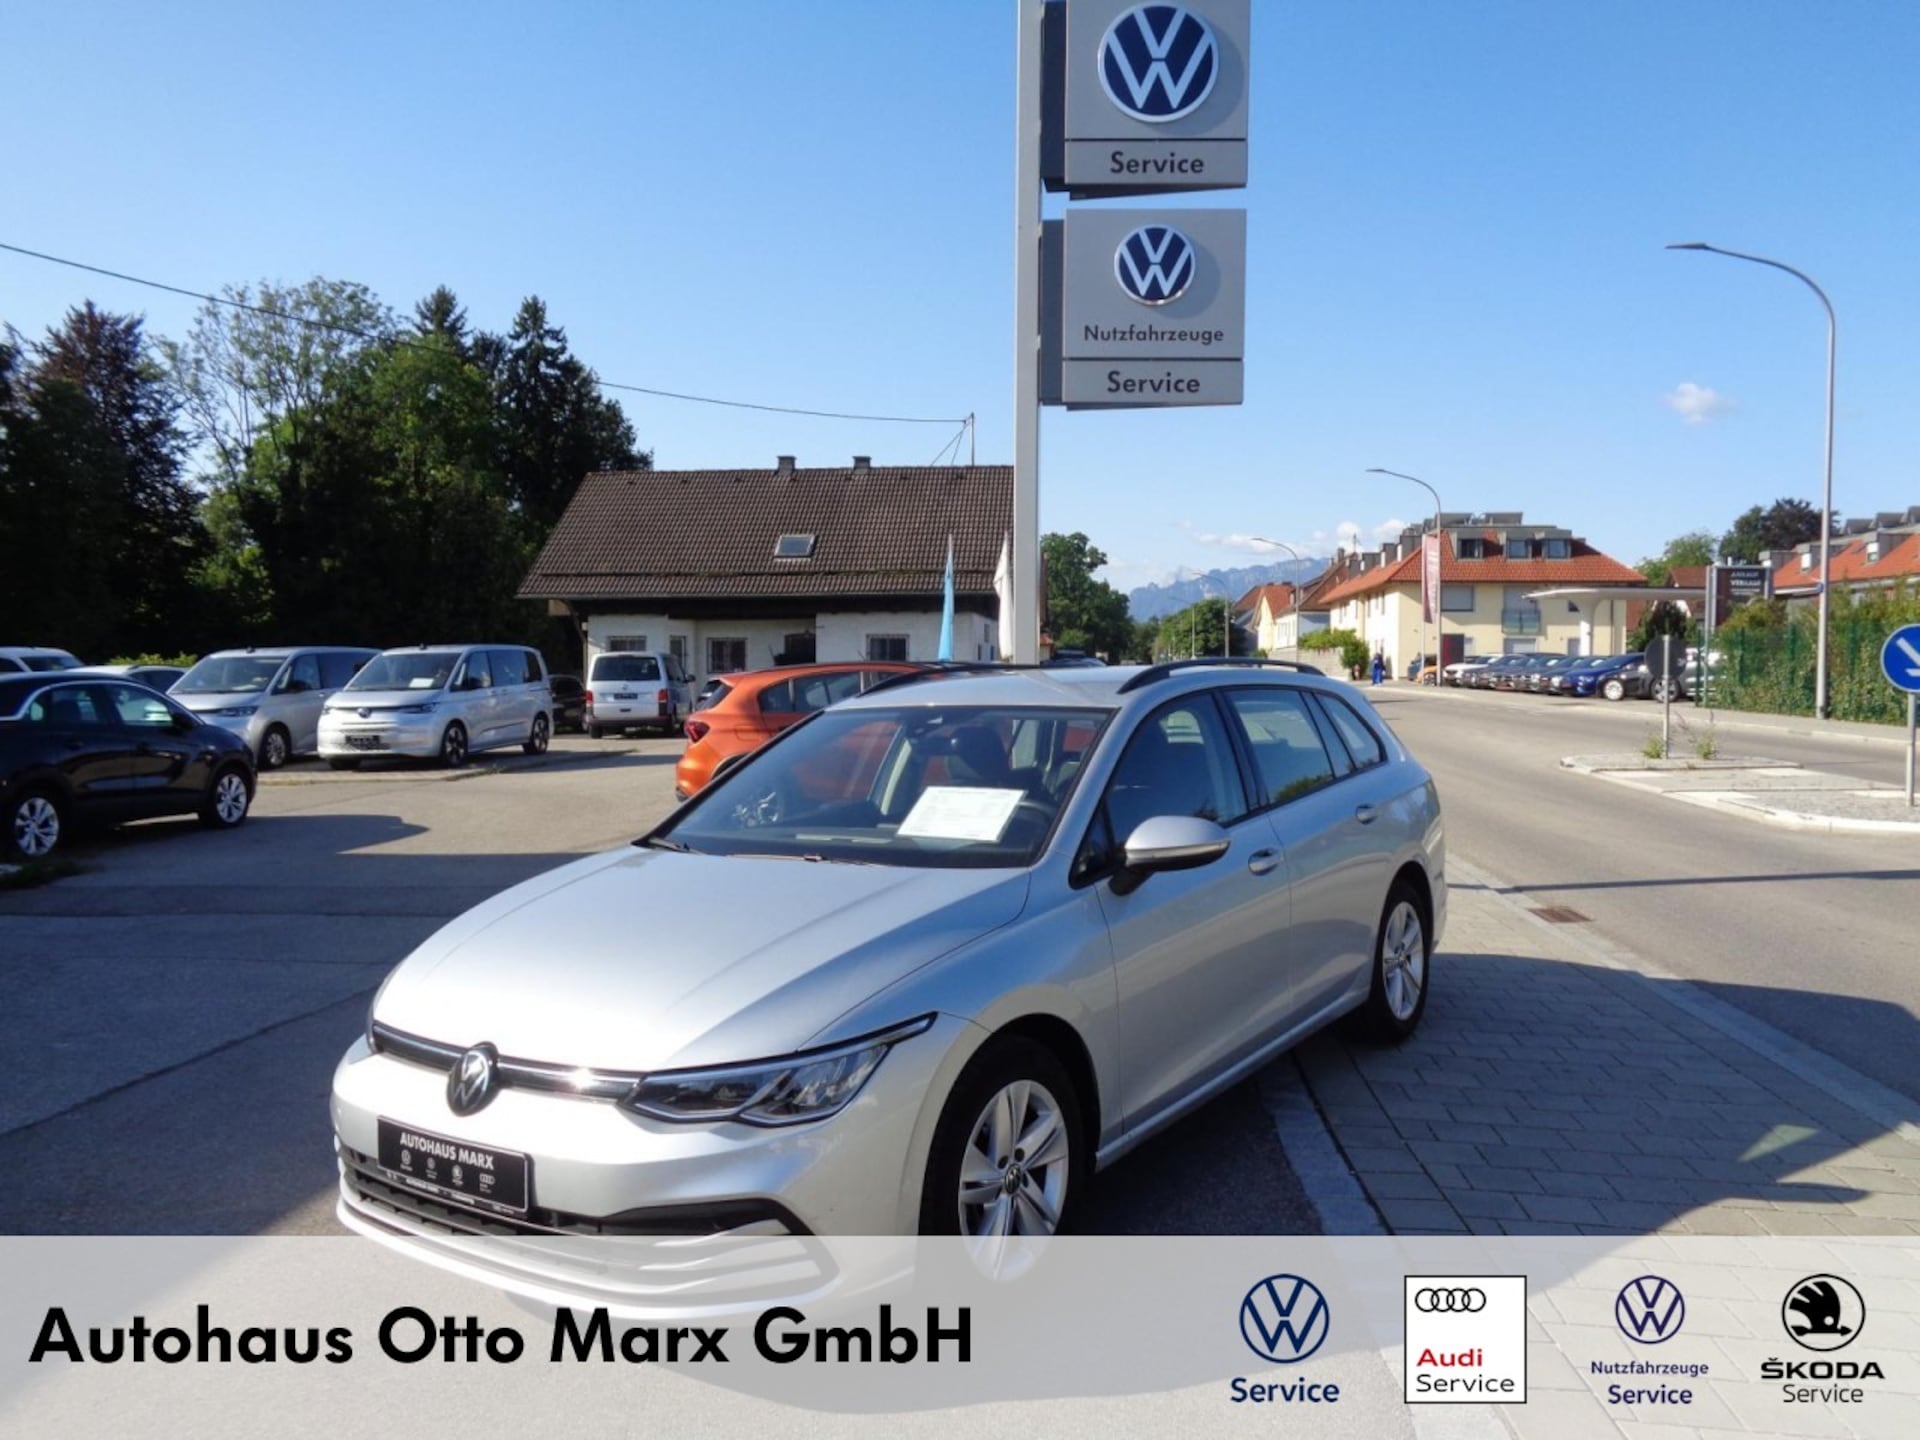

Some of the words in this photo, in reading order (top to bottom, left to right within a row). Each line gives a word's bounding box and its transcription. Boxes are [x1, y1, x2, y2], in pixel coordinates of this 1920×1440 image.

[1109, 150, 1205, 175] Service
[1083, 324, 1225, 346] Nutzfahrzeuge
[1106, 370, 1201, 394] Service
[399, 1132, 457, 1161] AUTOHAUS
[458, 1148, 495, 1171] MARX
